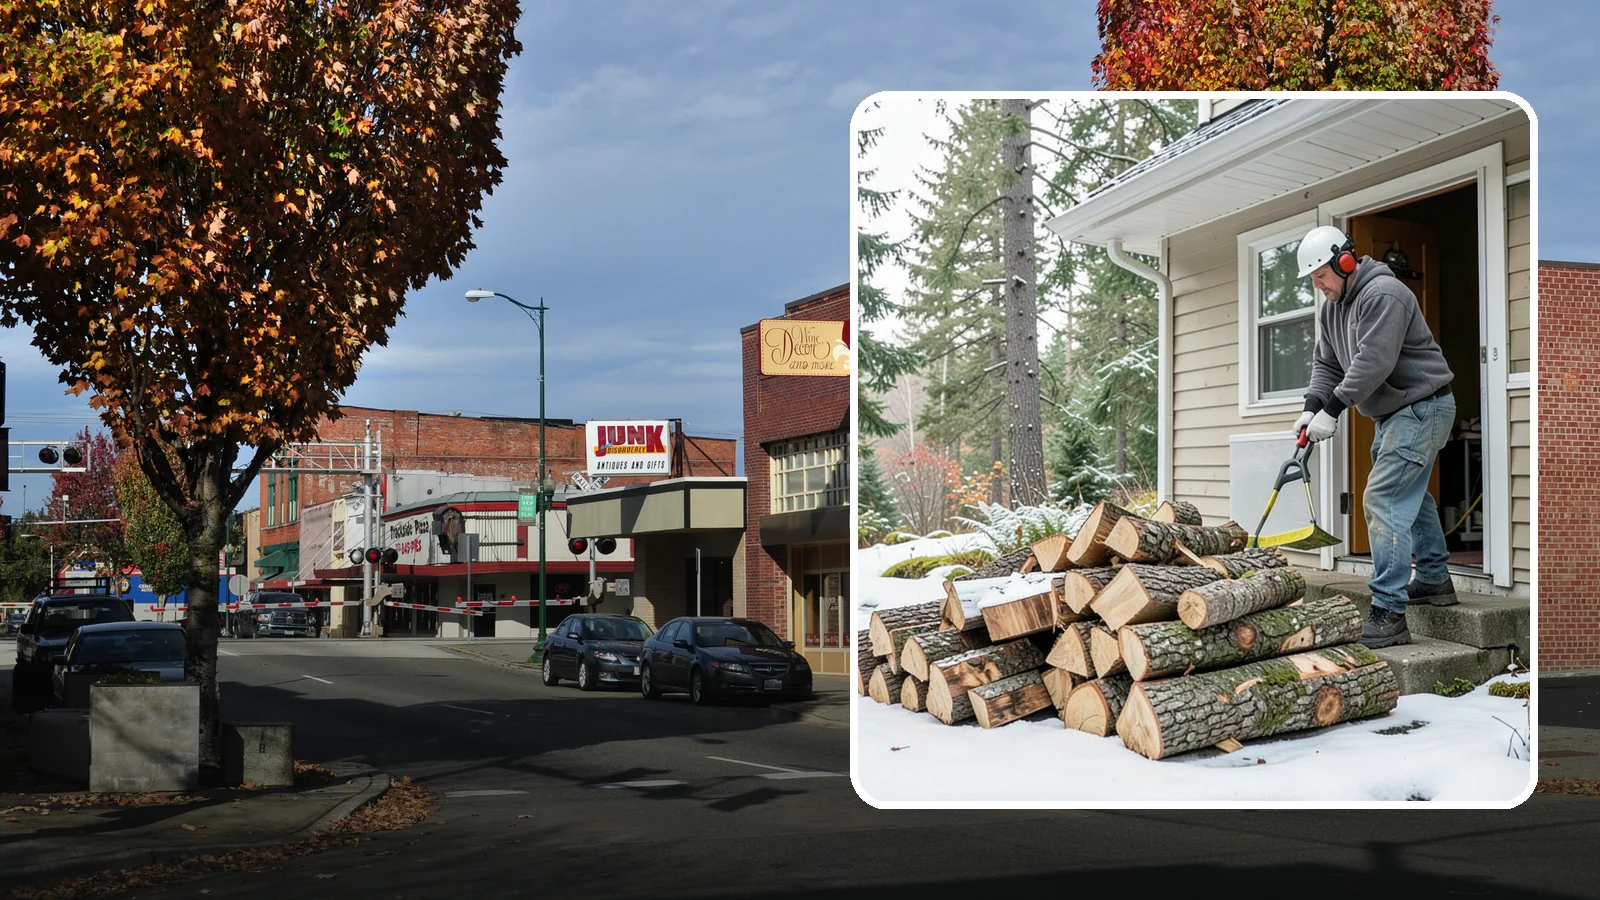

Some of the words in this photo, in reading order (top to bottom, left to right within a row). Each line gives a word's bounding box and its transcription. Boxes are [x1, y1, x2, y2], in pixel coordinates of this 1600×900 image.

[595, 425, 665, 457] JUNK
[597, 461, 628, 470] ANTIQUES
[631, 461, 644, 470] AND
[647, 461, 665, 470] GIFTS
[390, 522, 413, 540] Trackside
[414, 519, 429, 535] Pizza
